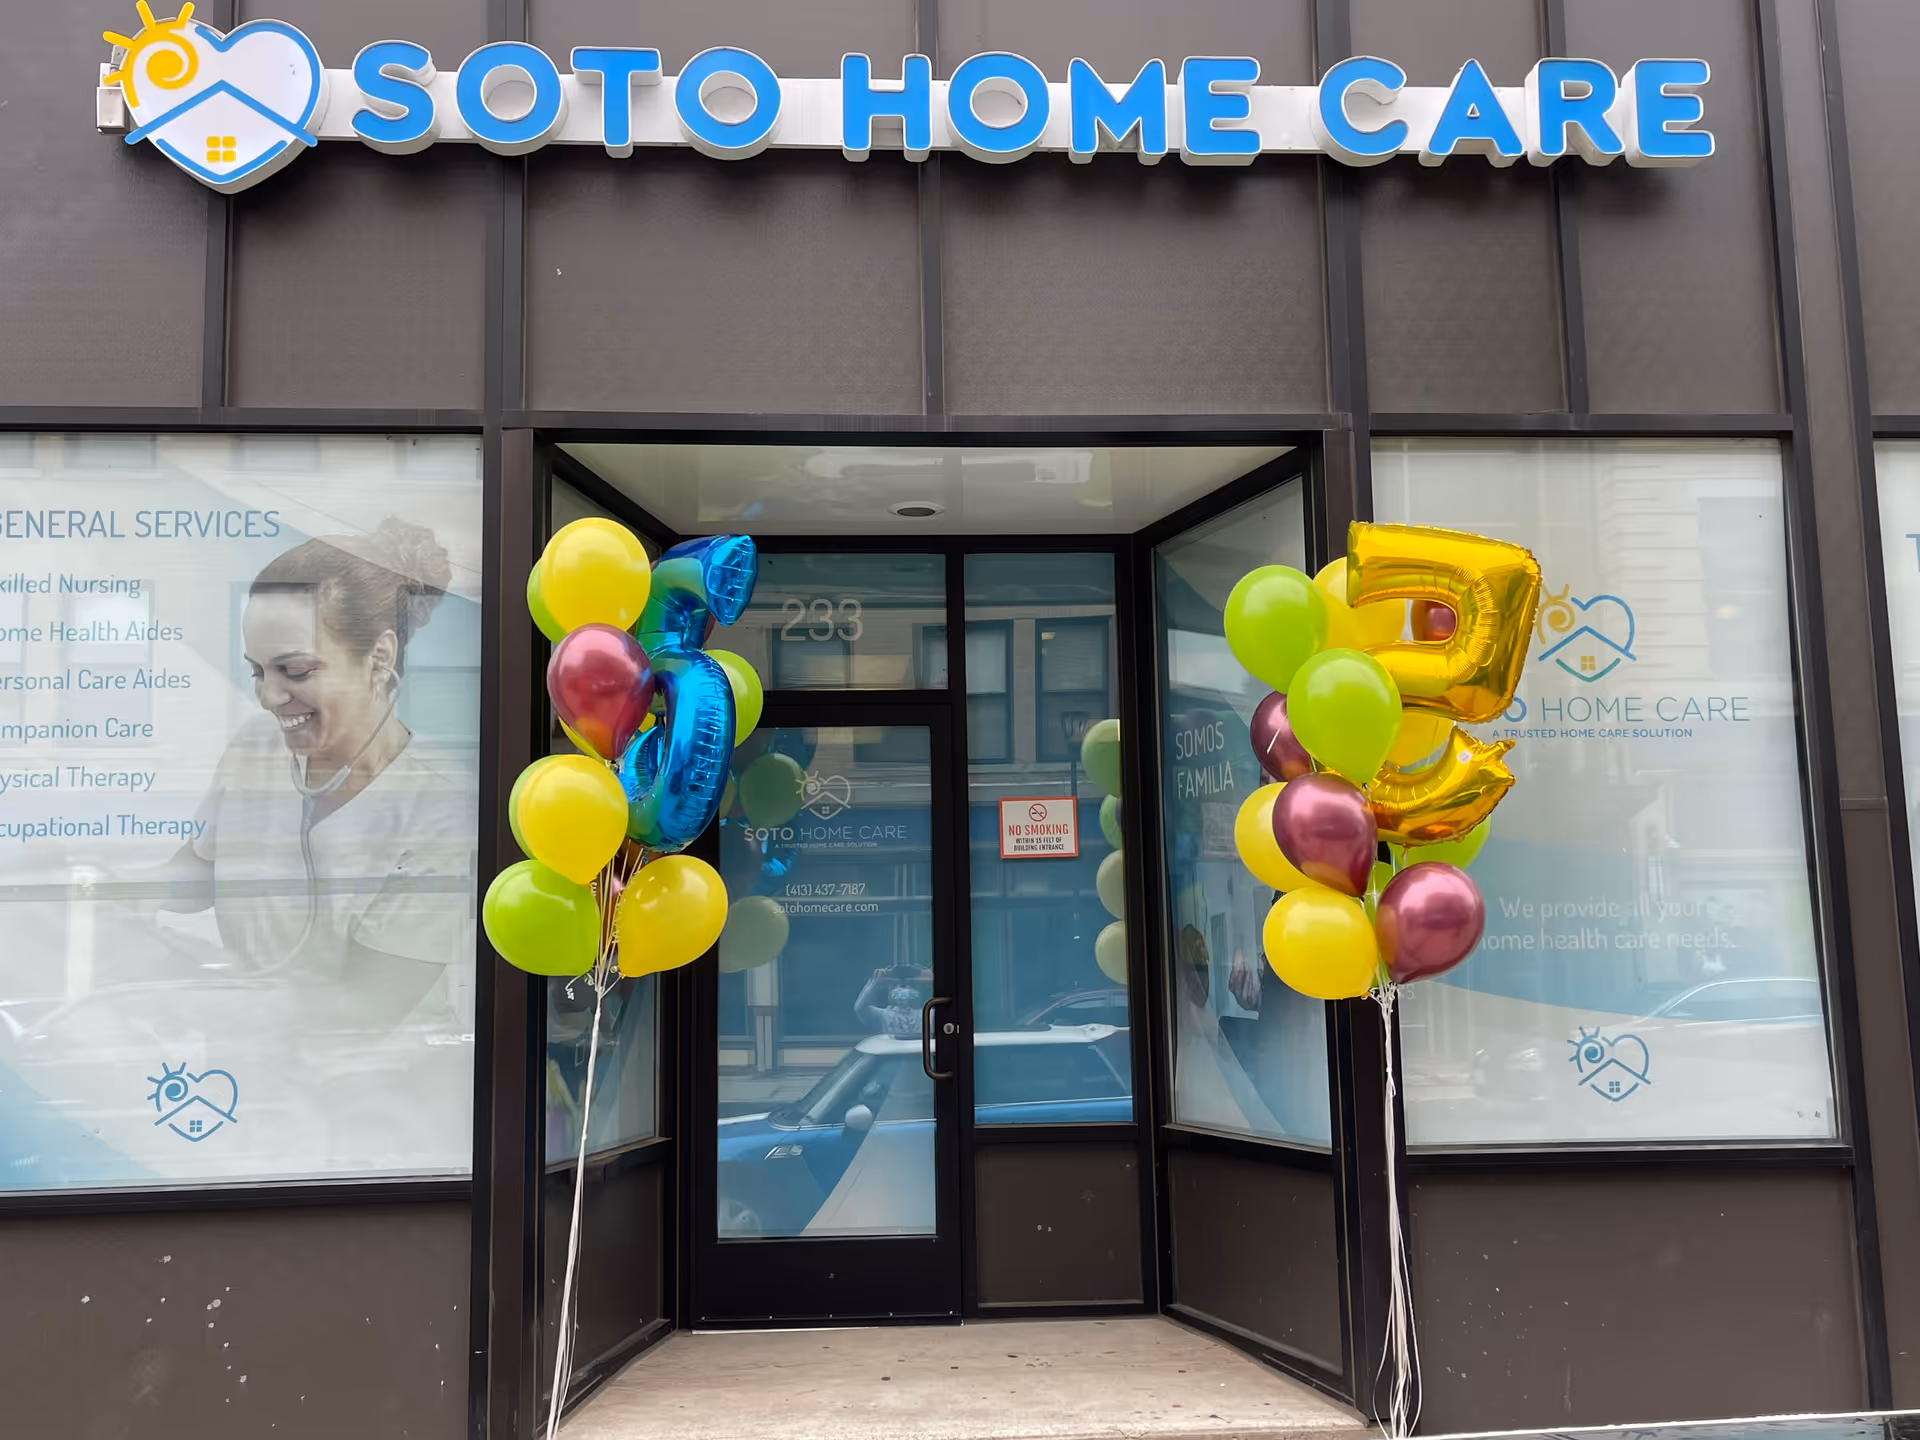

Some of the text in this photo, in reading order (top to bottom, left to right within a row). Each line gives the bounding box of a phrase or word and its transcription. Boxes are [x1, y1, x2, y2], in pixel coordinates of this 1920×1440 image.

[350, 39, 1716, 165] SOTO HOME CARE
[0, 510, 281, 538] ENERAL SERVICES
[59, 573, 142, 599] Nursing
[50, 622, 119, 642] Health
[125, 621, 183, 641] Aides
[781, 598, 863, 641] 233
[78, 669, 127, 689] Care
[133, 668, 192, 689] Aides
[1542, 696, 1643, 722] HOME
[1655, 695, 1751, 722] CARE
[105, 718, 154, 738] Care
[1492, 728, 1693, 738] A TRUSTED HOME CARE SOLUTION
[1175, 721, 1225, 761] SOMOS
[67, 766, 156, 792] Therapy
[1177, 760, 1235, 800] FAMILIA
[117, 814, 207, 840] Therapy
[744, 825, 908, 842] SOTO HOME CARE
[1008, 823, 1069, 836] NO SMOKING
[785, 882, 866, 896] (413) 437-7187
[773, 902, 879, 914] sotohomecare.com
[1500, 897, 1534, 918] We
[1541, 897, 1620, 922] provide
[1541, 927, 1608, 950] health
[1615, 932, 1661, 949] care
